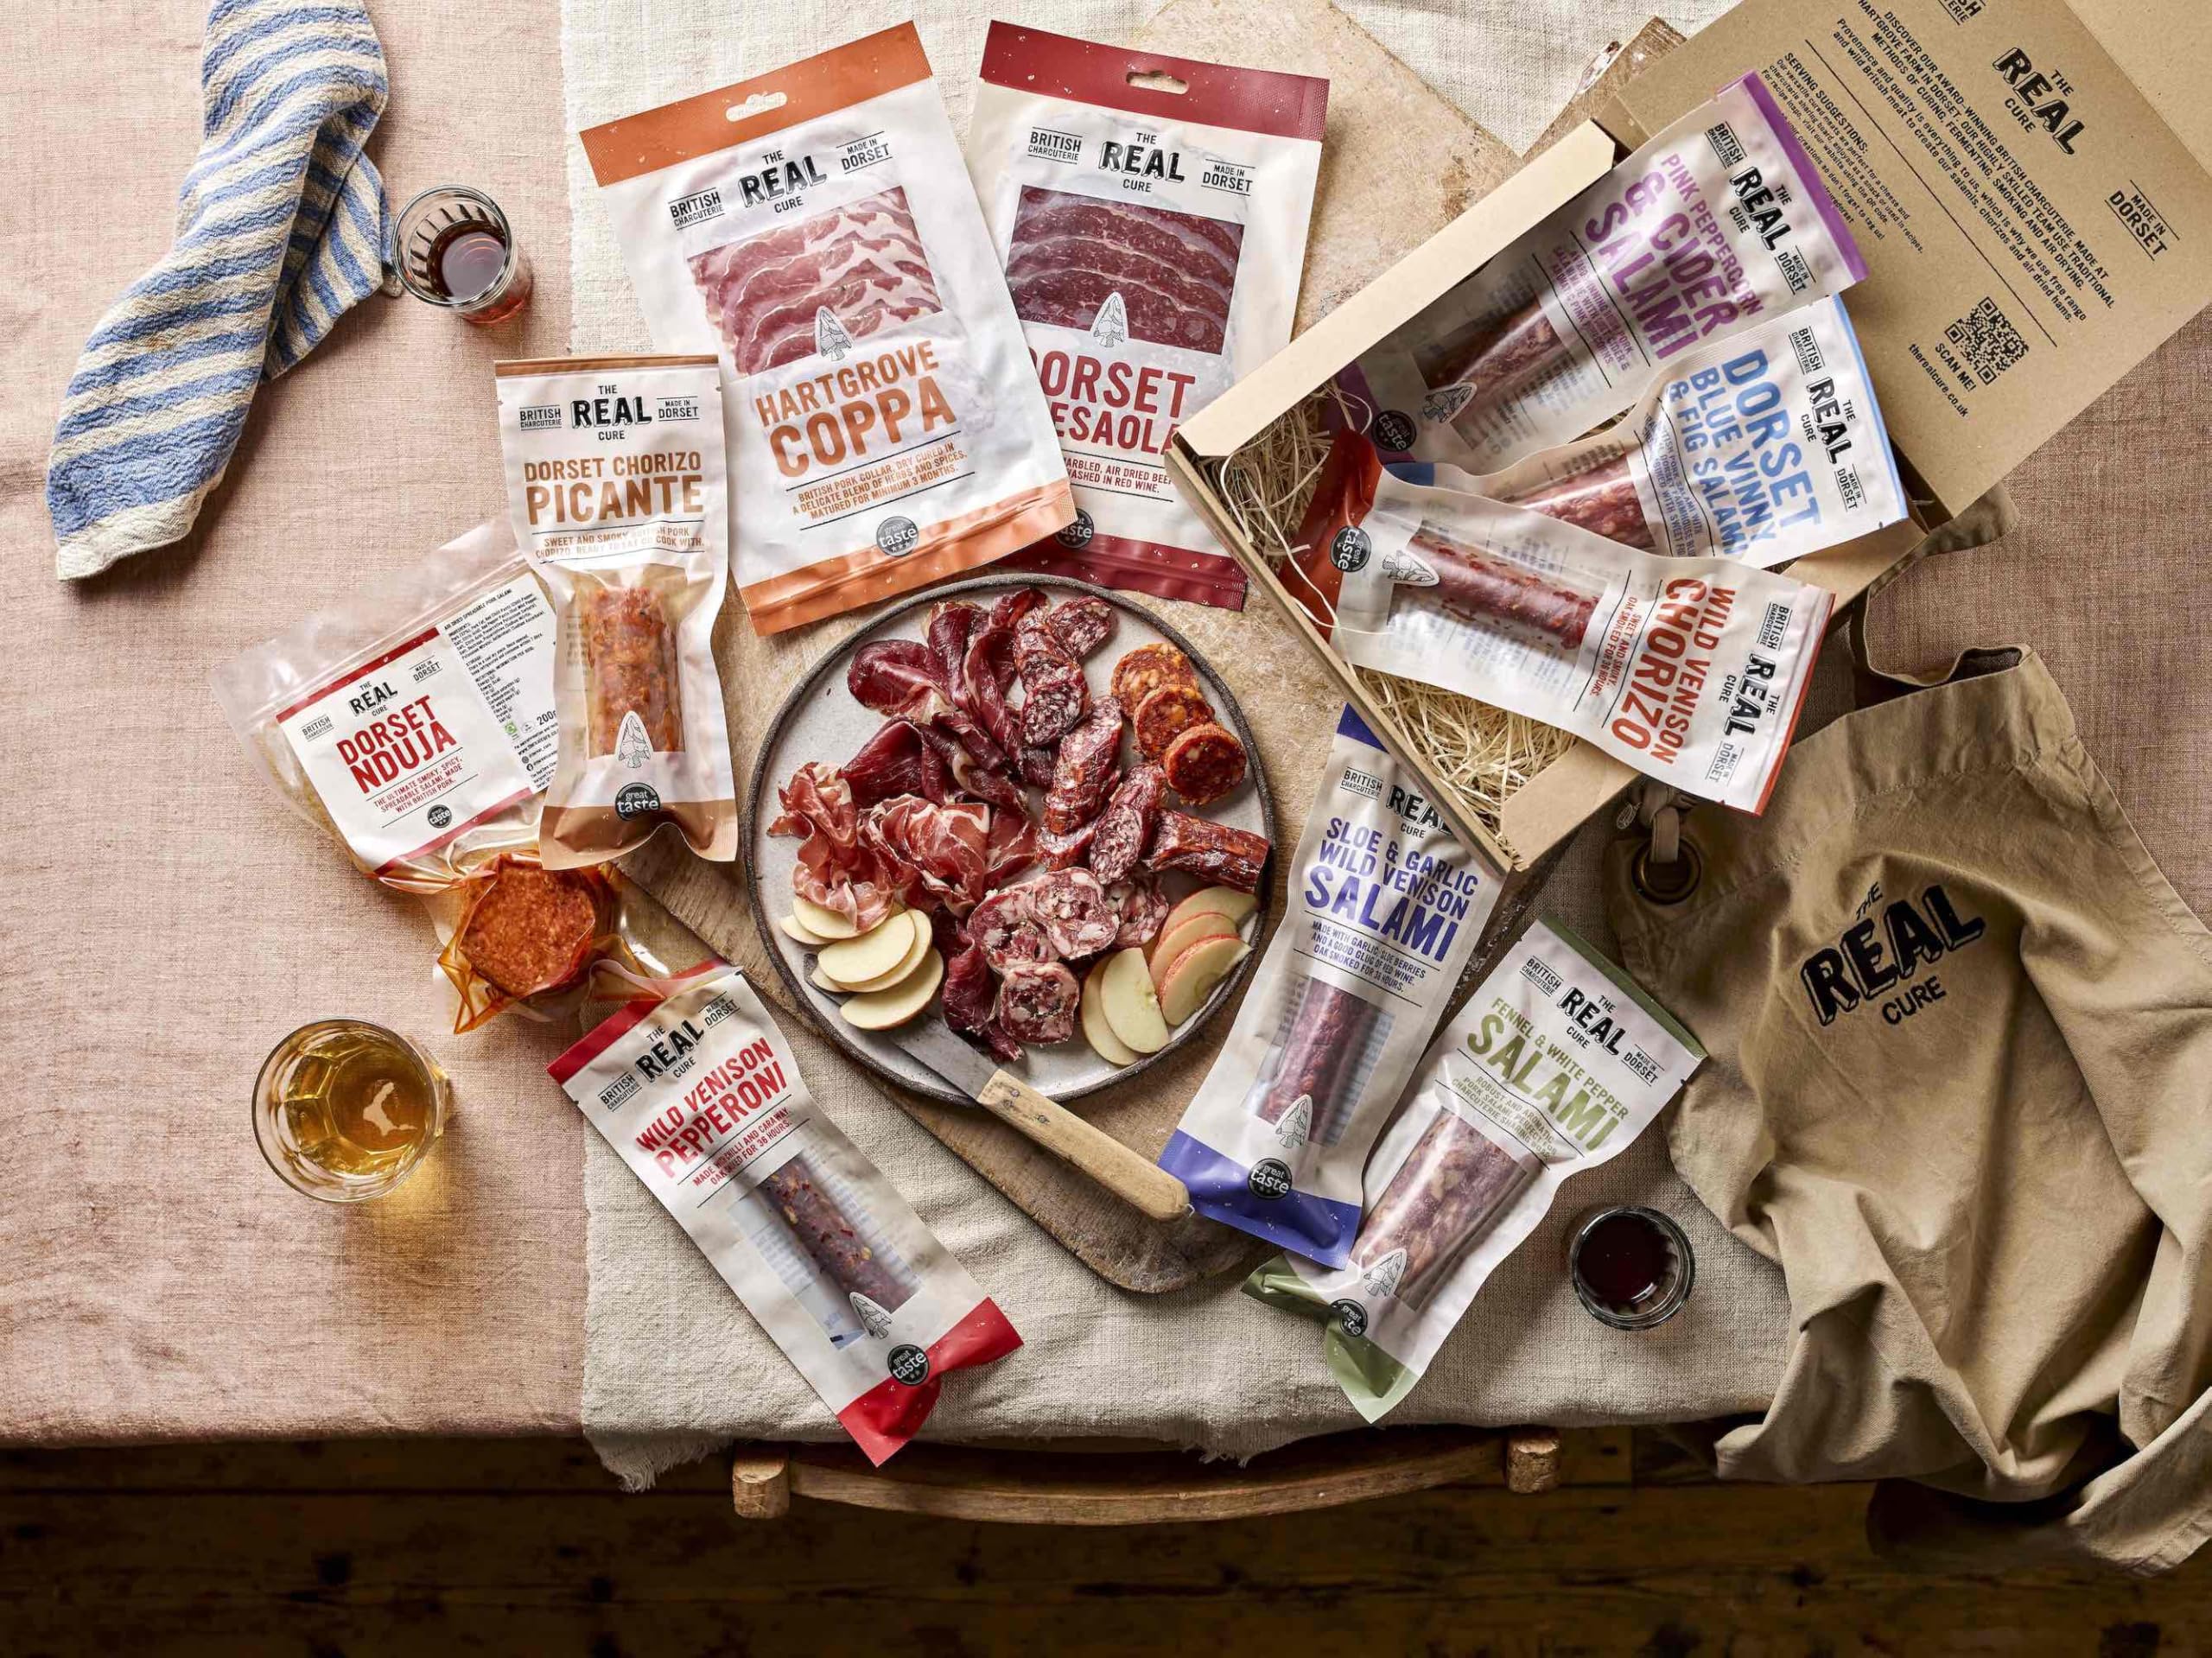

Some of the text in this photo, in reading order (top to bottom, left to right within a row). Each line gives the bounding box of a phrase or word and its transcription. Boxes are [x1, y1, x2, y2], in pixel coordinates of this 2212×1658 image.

[1784, 53, 1818, 92] SERVING
[2048, 69, 2074, 97] THE
[1993, 47, 2084, 156] REAL
[2003, 96, 2036, 133] CURE
[846, 142, 867, 155] MADE
[1029, 130, 1082, 153] BRITISH
[1135, 132, 1156, 144] THE
[1713, 122, 1745, 163] BRITISH
[1871, 31, 2056, 255] METHODS OF SMOKING AND AIR
[1883, 10, 2108, 281] DISCOVER OUR BRITISH MADE AT
[761, 149, 784, 165] THE
[841, 143, 892, 169] DORSET
[1098, 142, 1186, 183] REAL
[1213, 164, 1233, 175] MADE
[1822, 143, 1845, 169] website
[1832, 30, 2054, 296] and wild British meat create our chorizos and dried
[1836, 17, 2087, 322] Provenance and quality everything which why use free range
[1847, 145, 1869, 170] perfect
[738, 156, 827, 208] REAL
[1122, 179, 1152, 192] CURE
[1202, 172, 1253, 192] DORSET
[1773, 184, 1792, 206] THE
[1863, 179, 1880, 199] snack
[1899, 47, 2116, 308] FARM OUR HIGHLY SKILLED TEAM USE TRADITIONAL
[669, 191, 721, 219] BRITISH
[773, 195, 804, 213] CURE
[1730, 167, 1791, 251] REAL
[1840, 188, 1860, 211] forget
[2130, 194, 2166, 235] MADE IN
[1660, 152, 1764, 315] PINK PEPPERCORN
[1727, 206, 1751, 233] CURE
[2108, 188, 2167, 258] DORSET
[1625, 171, 1737, 339] & CIDER
[1775, 251, 1808, 294] DORSET
[1585, 202, 1699, 359] SALAMI
[1798, 327, 1821, 372] BRITISH
[1934, 342, 1977, 392] SCAN ME!
[598, 384, 616, 394] THE
[755, 340, 939, 428] HARTGROVE
[1907, 342, 1969, 417] therealcure.co.uk
[520, 408, 560, 421] BRITISH
[571, 396, 652, 429] REAL
[658, 406, 698, 418] DORSET
[769, 376, 957, 478] COPPA
[1666, 379, 1691, 402] &
[1682, 408, 1710, 452] FIG
[1799, 414, 1816, 442] CURE
[1807, 378, 1853, 464] REAL
[1841, 399, 1856, 422] THE
[598, 430, 625, 441] CURE
[1377, 413, 1408, 451] taste
[1722, 348, 1822, 529] DORSET
[524, 451, 701, 482] DORSET CHORIZO
[1690, 366, 1775, 545] BLUE VINNY
[1115, 478, 1132, 488] RED
[1122, 468, 1149, 480] DRIED
[1835, 468, 1857, 510] DORSET
[525, 474, 703, 525] PICANTE
[878, 526, 918, 548] taste
[1337, 528, 1359, 570] taste
[1766, 606, 1789, 650] BRITISH
[412, 661, 441, 681] DORSET
[1611, 578, 1693, 751] CHORIZO
[1650, 584, 1735, 765] WILD VENISON
[348, 681, 398, 716] REAL
[359, 681, 372, 691] THE
[1718, 673, 1736, 703] CURE
[1724, 653, 1775, 736] REAL
[371, 703, 388, 717] CURE
[1765, 693, 1779, 715] THE
[301, 715, 331, 736] BRITISH
[337, 695, 442, 765] DORSET
[349, 722, 456, 793] NDUJA
[1708, 741, 1732, 784] DORSET
[1343, 770, 1383, 791] BRITISH
[379, 787, 420, 813] SPREADABLE
[617, 798, 658, 812] taste
[1399, 823, 1426, 839] CURE
[1327, 817, 1480, 897] SLOE & GARLIC
[1319, 840, 1470, 919] WILD VENISON
[1304, 865, 1460, 962] SALAMI
[1856, 882, 1883, 921] THE
[1392, 957, 1427, 978] BERRIES
[1801, 885, 1986, 1026] REAL
[1526, 957, 1561, 990] BRITISH
[703, 998, 738, 1027] DORSET
[1597, 994, 1616, 1013] THE
[1882, 976, 1947, 1025] CURE
[645, 1024, 666, 1043] THE
[1558, 987, 1627, 1057] REAL
[1565, 1026, 1590, 1049] CURE
[636, 1020, 704, 1083] REAL
[673, 1058, 696, 1078] CURE
[1491, 995, 1630, 1120] FENNEL & WHITE PEPPER
[1623, 1051, 1658, 1084] DORSET
[599, 1073, 636, 1105] BRITISH
[637, 1038, 773, 1153] WILD VENISON
[1467, 1013, 1619, 1151] SALAMI
[652, 1064, 788, 1178] PEPPERONI
[741, 1129, 760, 1145] AND
[1249, 1168, 1291, 1193] taste
[893, 1352, 926, 1379] taste
